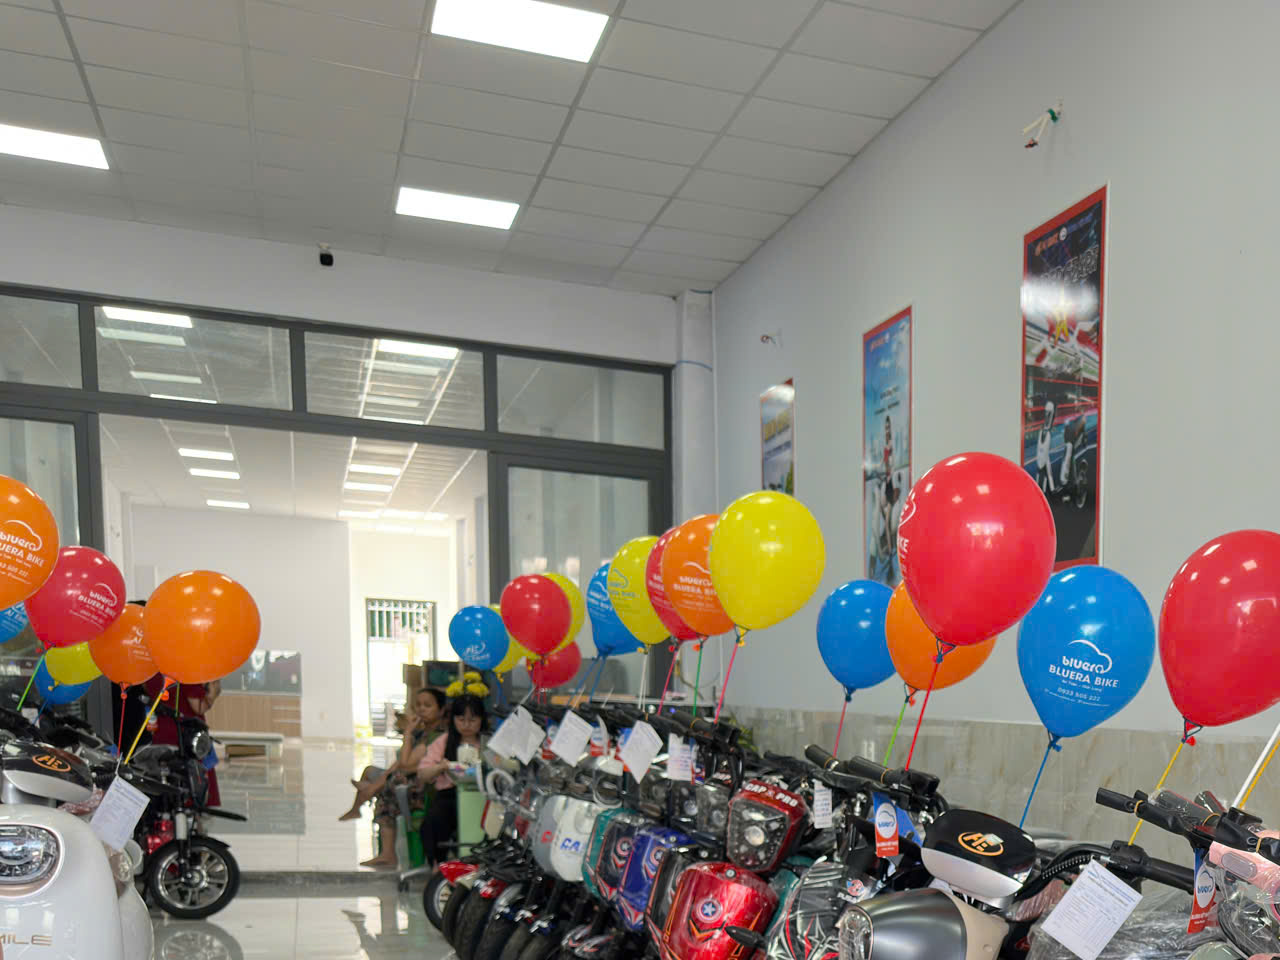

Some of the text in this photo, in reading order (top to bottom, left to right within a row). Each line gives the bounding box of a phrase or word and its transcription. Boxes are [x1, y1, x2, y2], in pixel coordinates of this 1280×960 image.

[0, 543, 24, 559] UERA
[1062, 655, 1108, 674] bluera
[1049, 664, 1091, 684] BLUERA
[1094, 676, 1119, 688] BIKE
[776, 792, 799, 807] PRO
